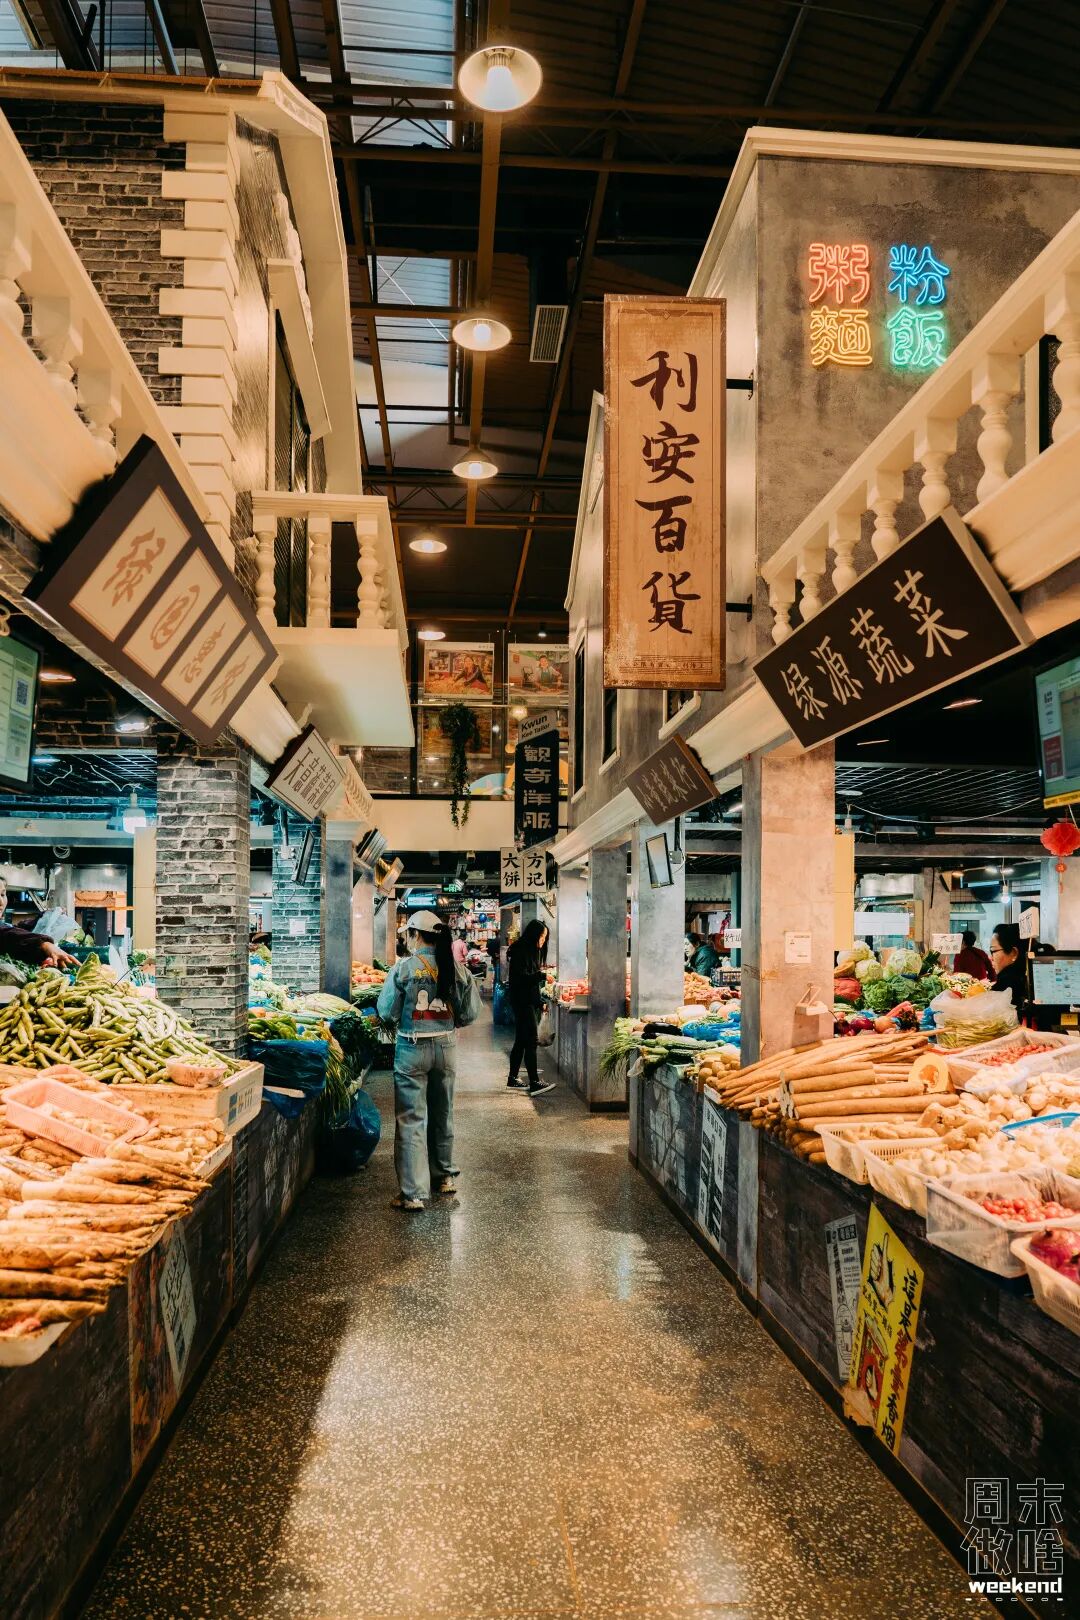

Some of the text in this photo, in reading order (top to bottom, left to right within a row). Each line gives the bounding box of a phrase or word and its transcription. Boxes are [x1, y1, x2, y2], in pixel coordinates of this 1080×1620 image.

[630, 350, 702, 635] 利安百貨
[780, 569, 969, 721] 绿源蔬菜
[521, 715, 548, 732] Kwun
[534, 723, 550, 734] Tailor
[503, 853, 521, 888] 大饼
[526, 853, 545, 887] 方记
